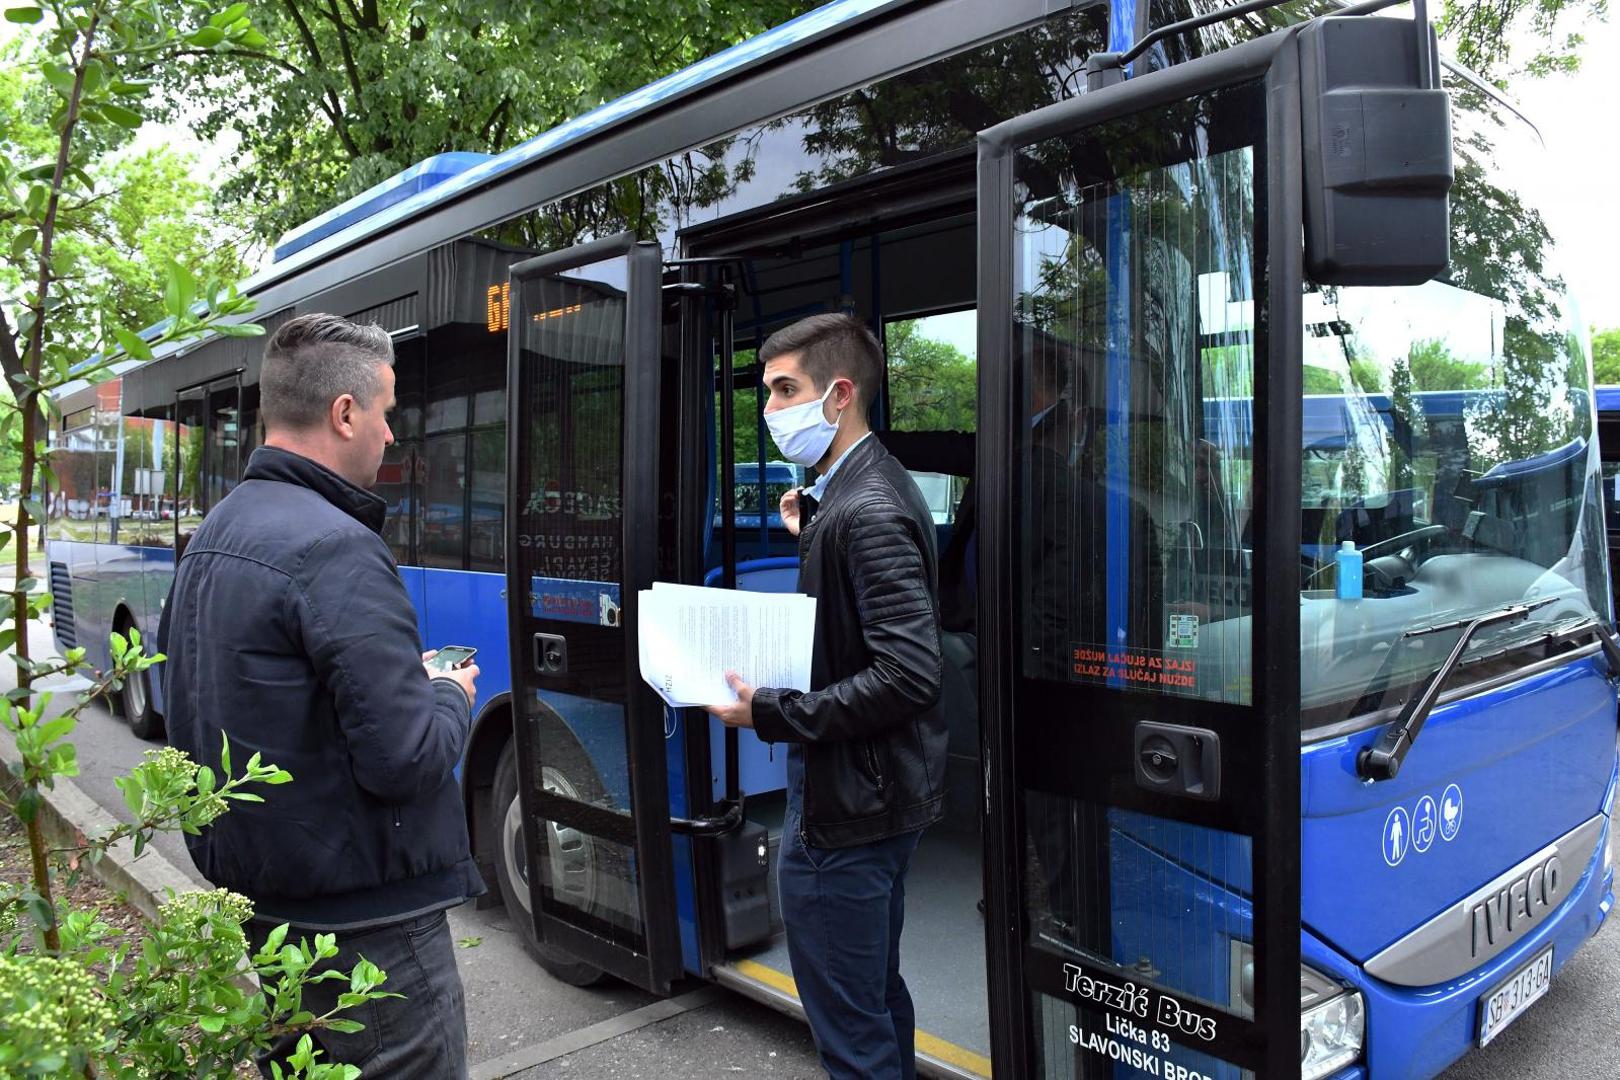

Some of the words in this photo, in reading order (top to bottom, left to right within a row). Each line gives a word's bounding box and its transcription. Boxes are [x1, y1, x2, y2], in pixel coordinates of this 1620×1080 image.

[1074, 663, 1101, 676] IZLAZ
[1103, 666, 1115, 678] ZA
[1118, 667, 1157, 683] SLUČAJ
[1159, 672, 1195, 687] NUŽDE
[1472, 855, 1562, 958] IVECO
[1063, 963, 1149, 1018] Terzić
[1157, 995, 1217, 1041] Bus
[1069, 1024, 1159, 1076] SLAVONSKI
[1164, 1060, 1213, 1080] BR
[1105, 1012, 1147, 1045] Lička
[1151, 1030, 1171, 1053] 83
